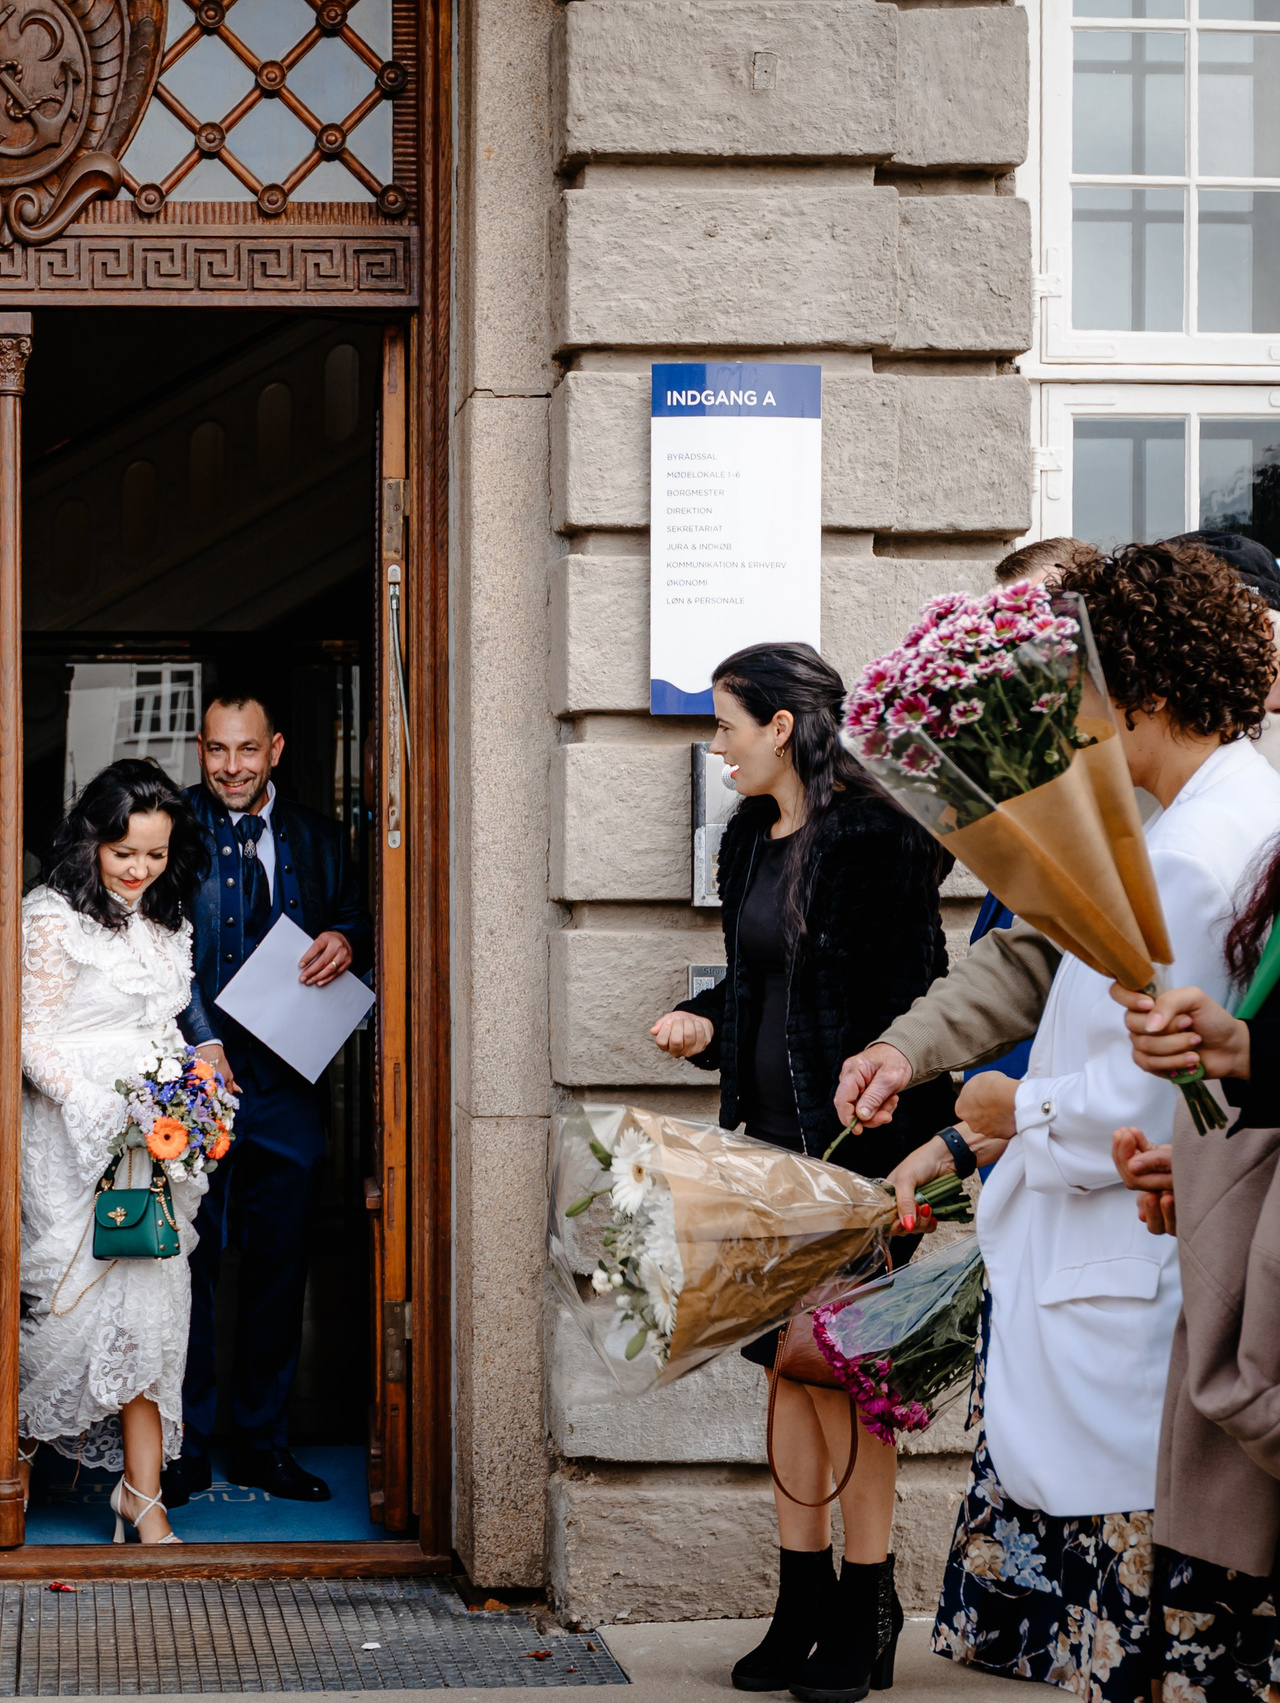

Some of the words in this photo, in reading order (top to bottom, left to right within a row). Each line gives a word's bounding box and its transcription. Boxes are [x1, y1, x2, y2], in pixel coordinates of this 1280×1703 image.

[666, 389, 758, 406] INDGANG
[762, 390, 777, 406] A
[666, 452, 718, 461] BYRÅDSSAL
[666, 470, 726, 479] MØDELOKALE
[666, 489, 725, 497] BORGMESTER
[666, 507, 713, 515] DIREKTION
[666, 525, 723, 533] SEKRETARIAT
[666, 543, 690, 551] JURA
[691, 543, 697, 551] &
[699, 543, 733, 551] INDKØB
[666, 561, 739, 569] KOMMUNIKATION
[740, 561, 746, 569] &
[748, 561, 787, 570] ERHVERV
[666, 579, 708, 587] ØKONOMI
[666, 597, 685, 605] LØN
[686, 597, 693, 605] &
[694, 597, 745, 605] PERSONALE
[703, 967, 725, 975] Strue
